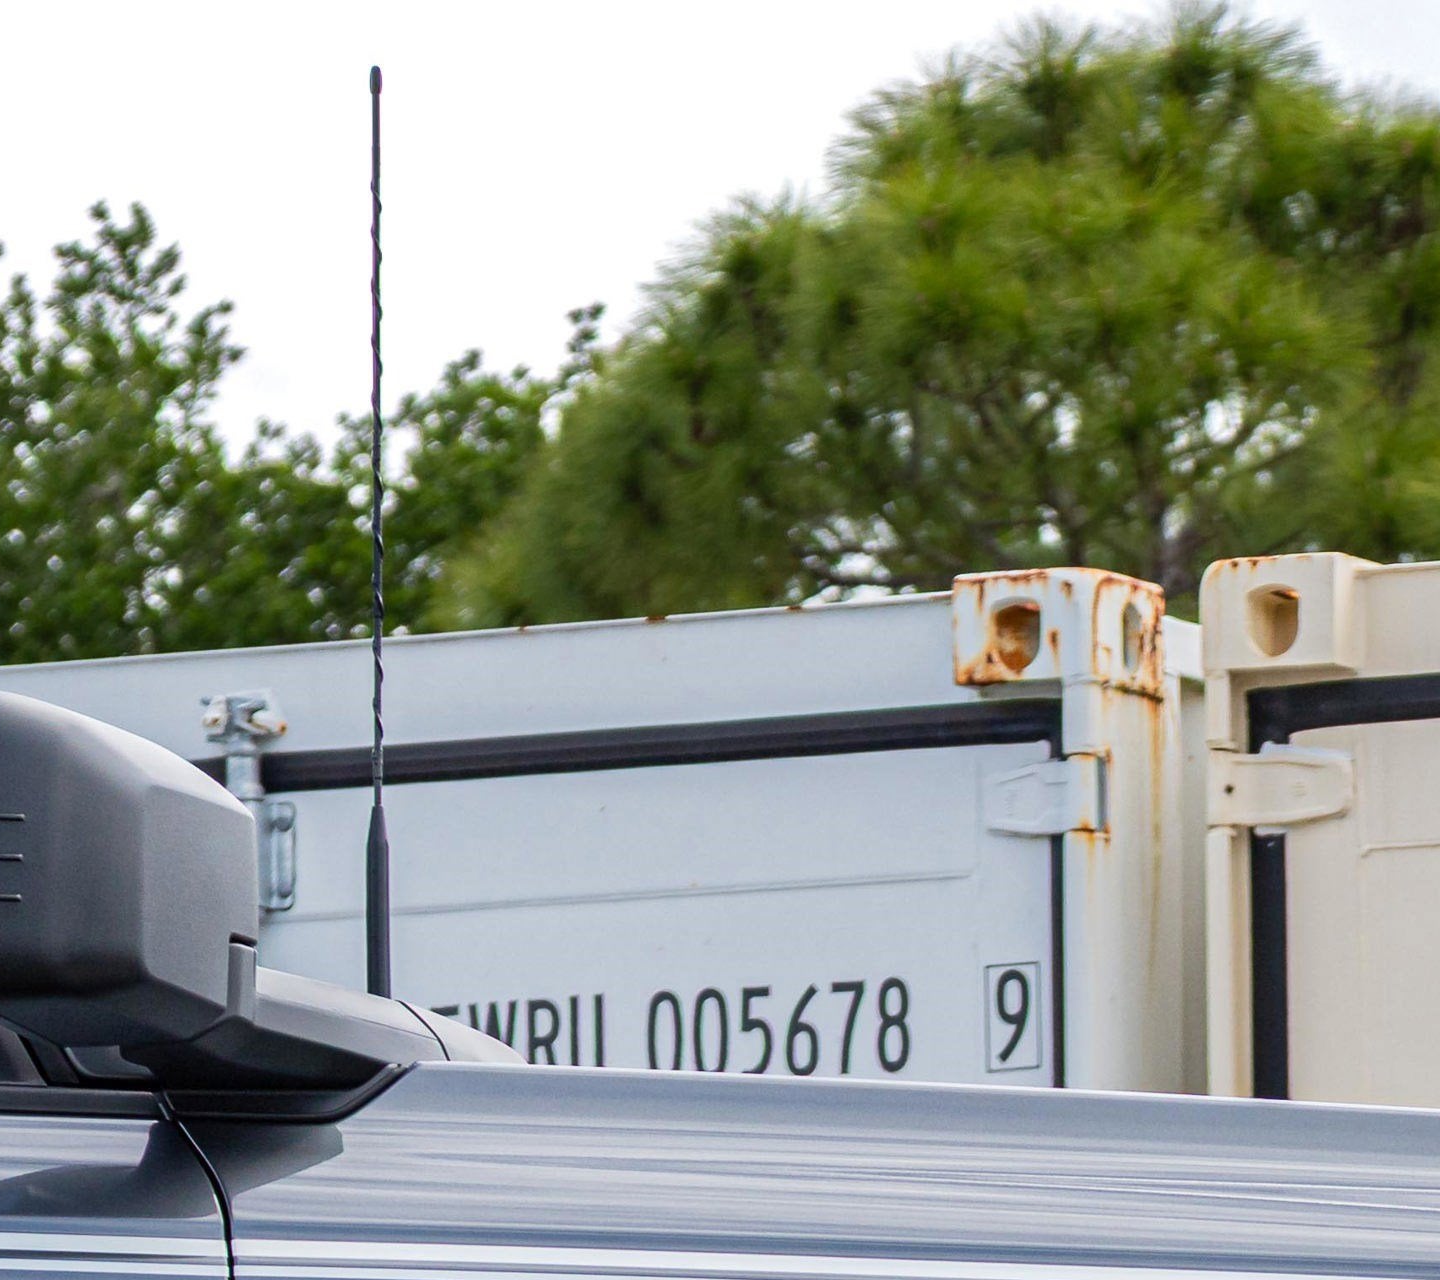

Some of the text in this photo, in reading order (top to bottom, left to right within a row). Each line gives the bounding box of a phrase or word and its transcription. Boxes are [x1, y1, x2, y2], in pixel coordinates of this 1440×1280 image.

[427, 968, 1031, 1077] WRU 005678 9
